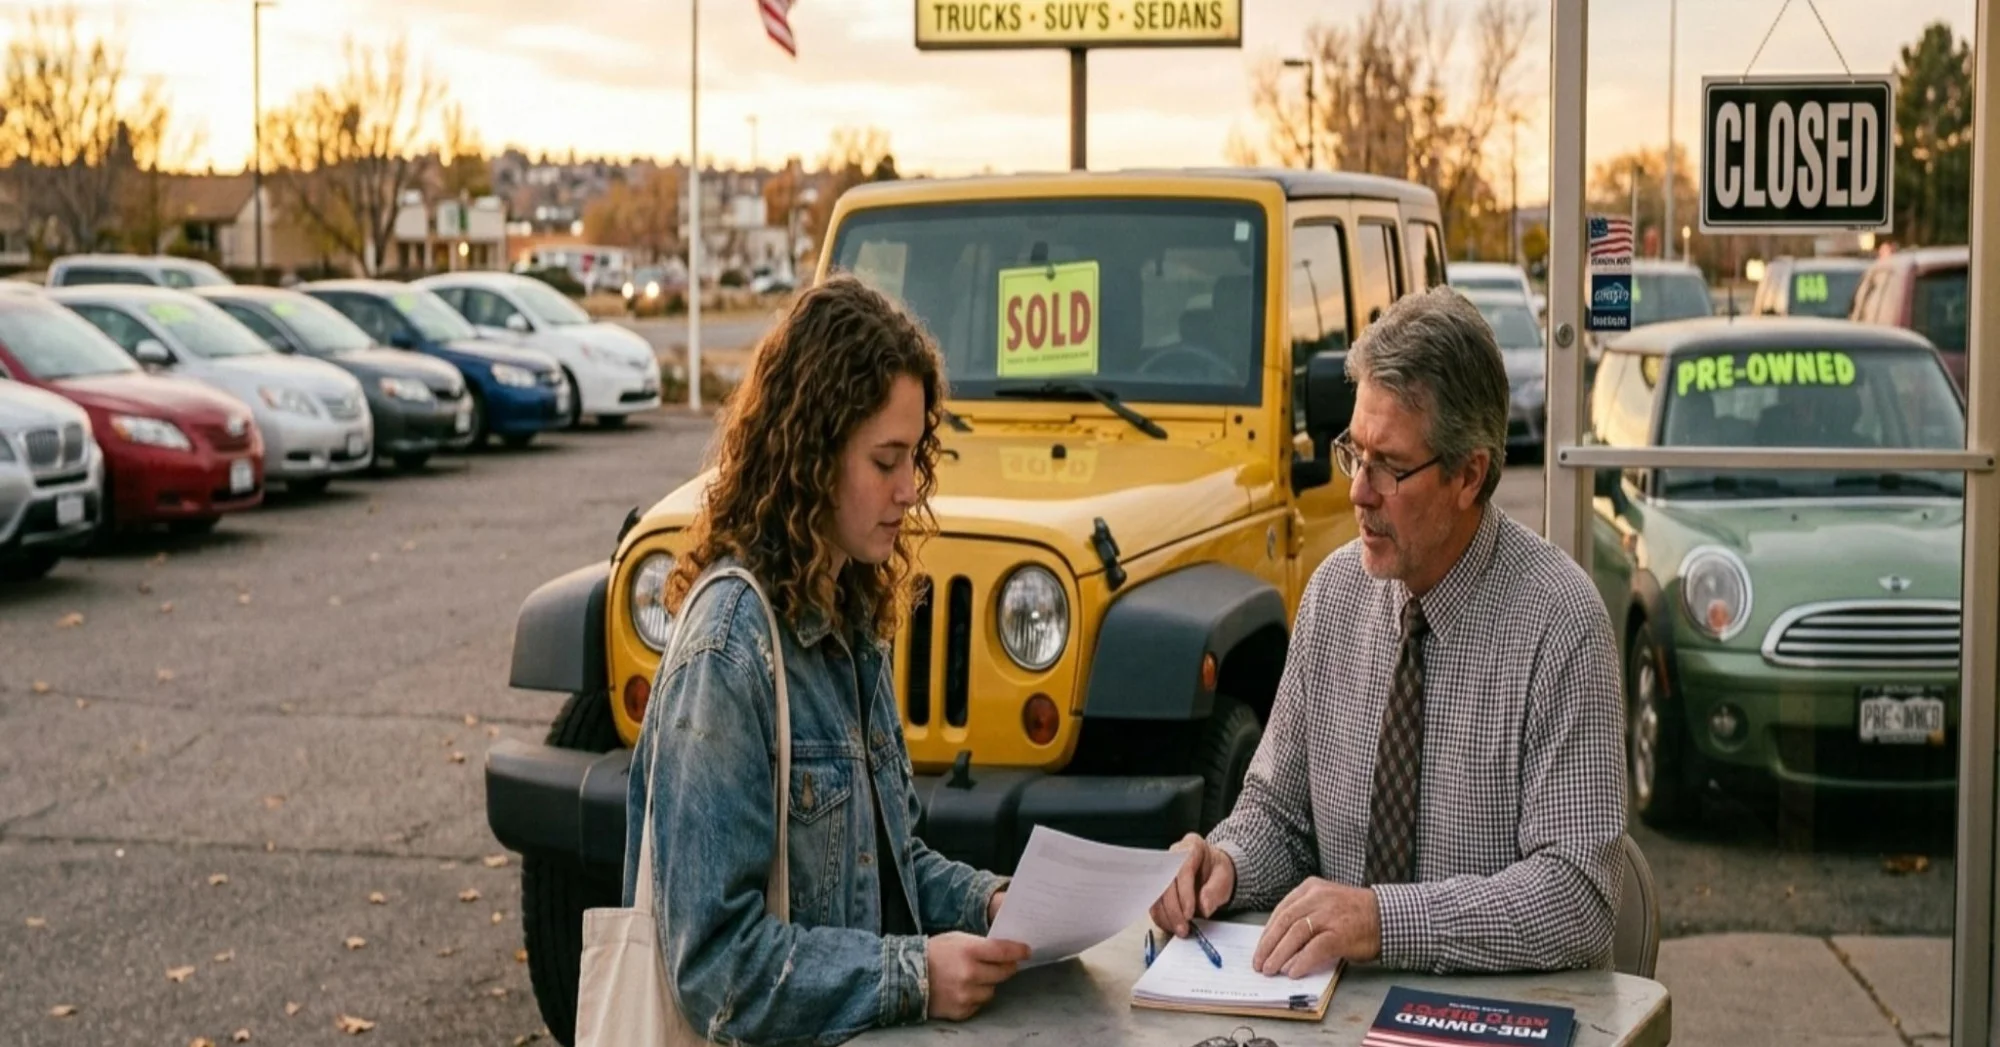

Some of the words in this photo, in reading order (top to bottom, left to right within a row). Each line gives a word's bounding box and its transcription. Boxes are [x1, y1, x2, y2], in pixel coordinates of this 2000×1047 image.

[933, 3, 1022, 32] TRUCKS
[1044, 3, 1110, 31] SUV'S
[1133, 1, 1223, 30] SEDANS
[1714, 100, 1879, 209] CLOSED
[1006, 289, 1091, 352] SOLD
[1677, 352, 1856, 397] PRE-OWNED
